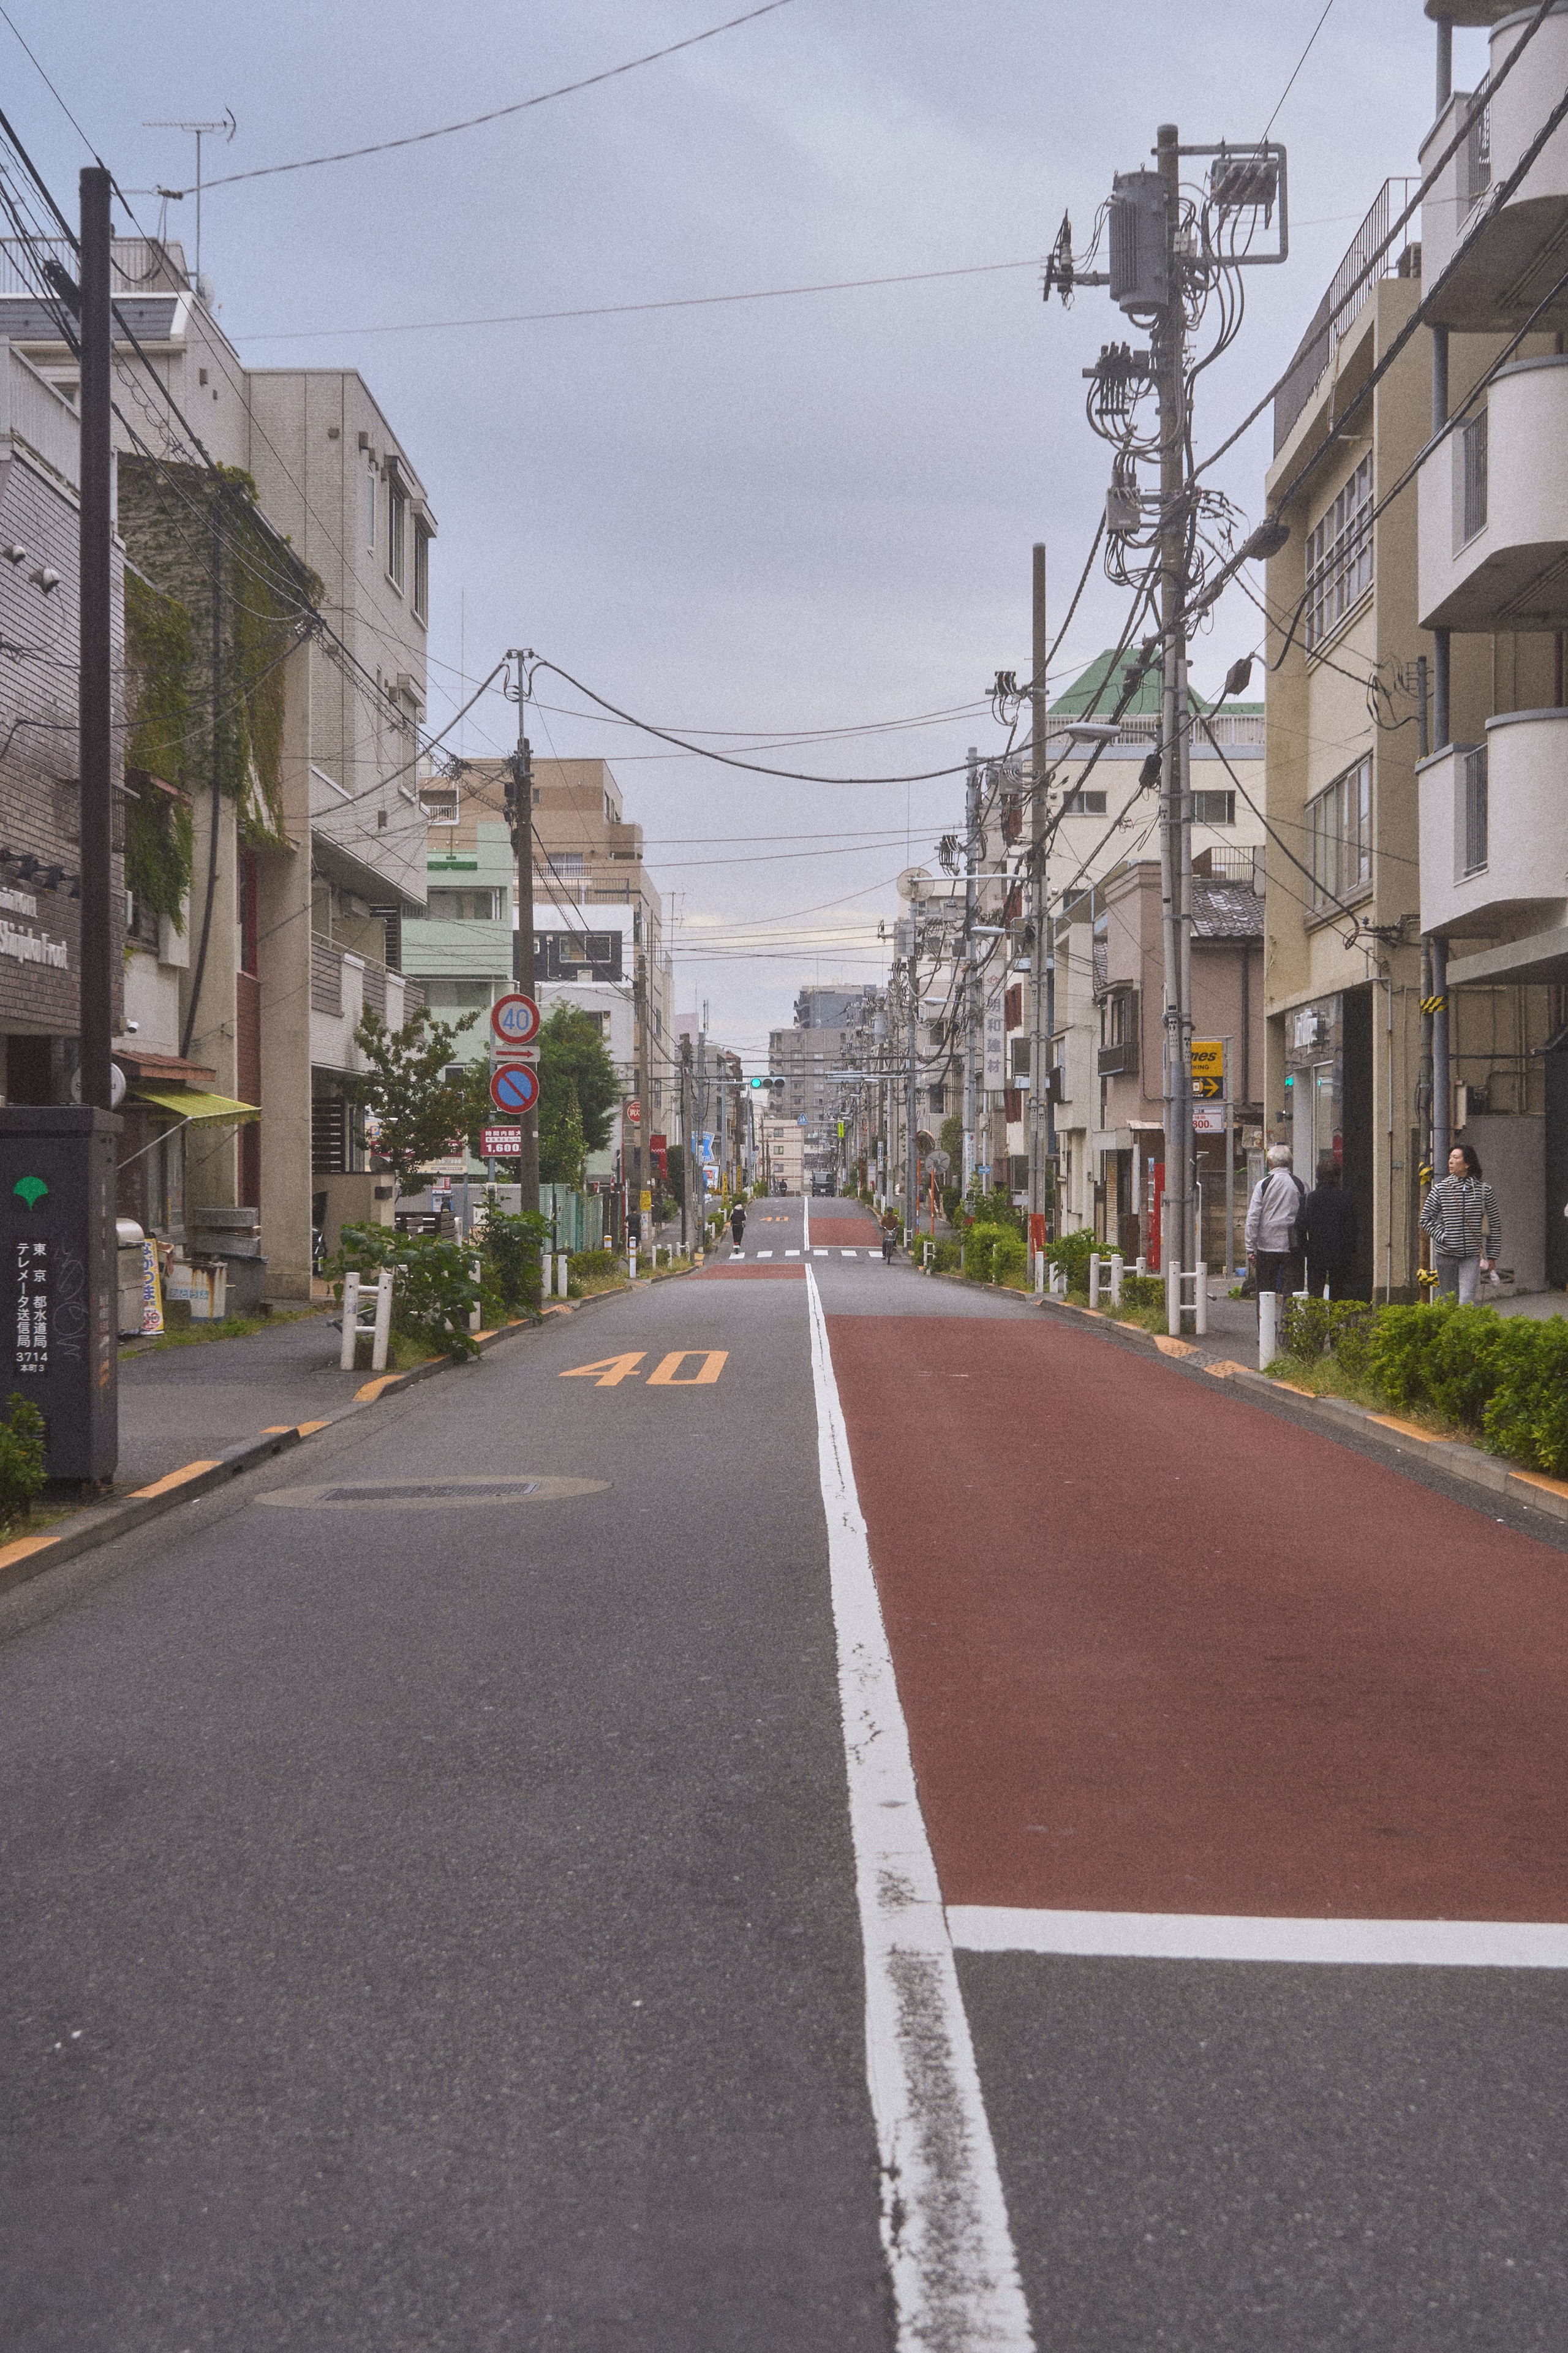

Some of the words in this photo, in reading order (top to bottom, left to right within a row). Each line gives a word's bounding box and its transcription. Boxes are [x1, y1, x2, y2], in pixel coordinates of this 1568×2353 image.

[502, 1008, 529, 1030] 40
[17, 1242, 31, 1348] テレメータ送信局
[33, 1242, 47, 1348] 東京都水道局
[16, 1351, 48, 1362] 3714
[557, 1350, 730, 1386] 40
